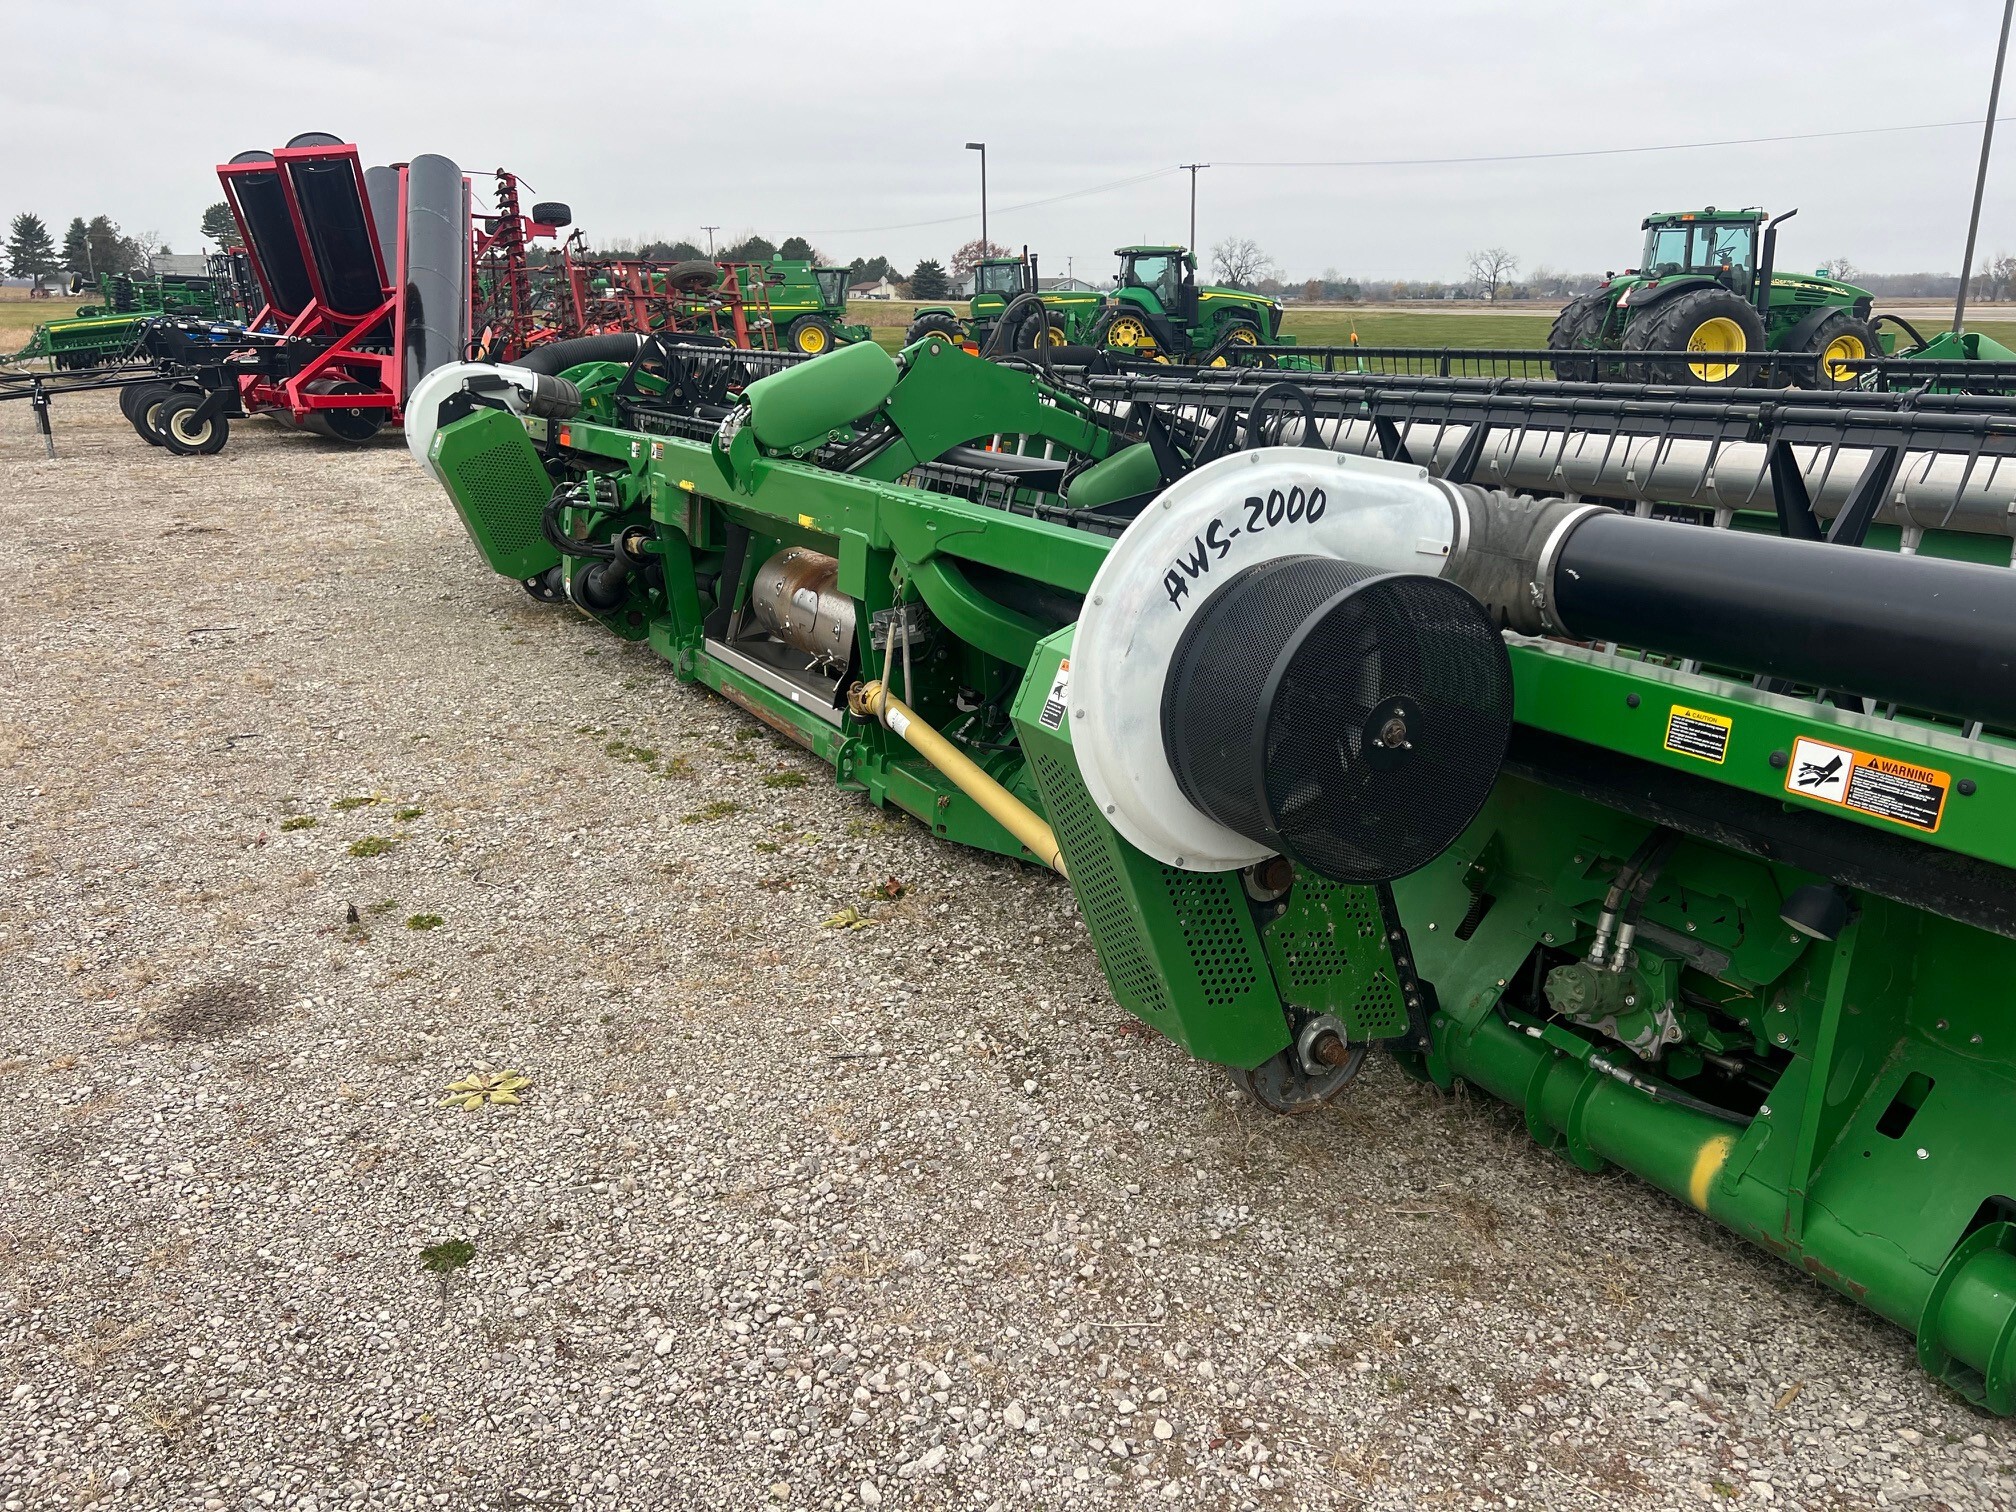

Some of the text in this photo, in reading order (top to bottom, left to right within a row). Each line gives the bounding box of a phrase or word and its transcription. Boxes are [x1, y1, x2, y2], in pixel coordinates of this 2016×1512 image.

[1163, 485, 1327, 612] AWS-2000
[1692, 712, 1718, 723] CAUTION
[1881, 761, 1934, 784] WARNING
